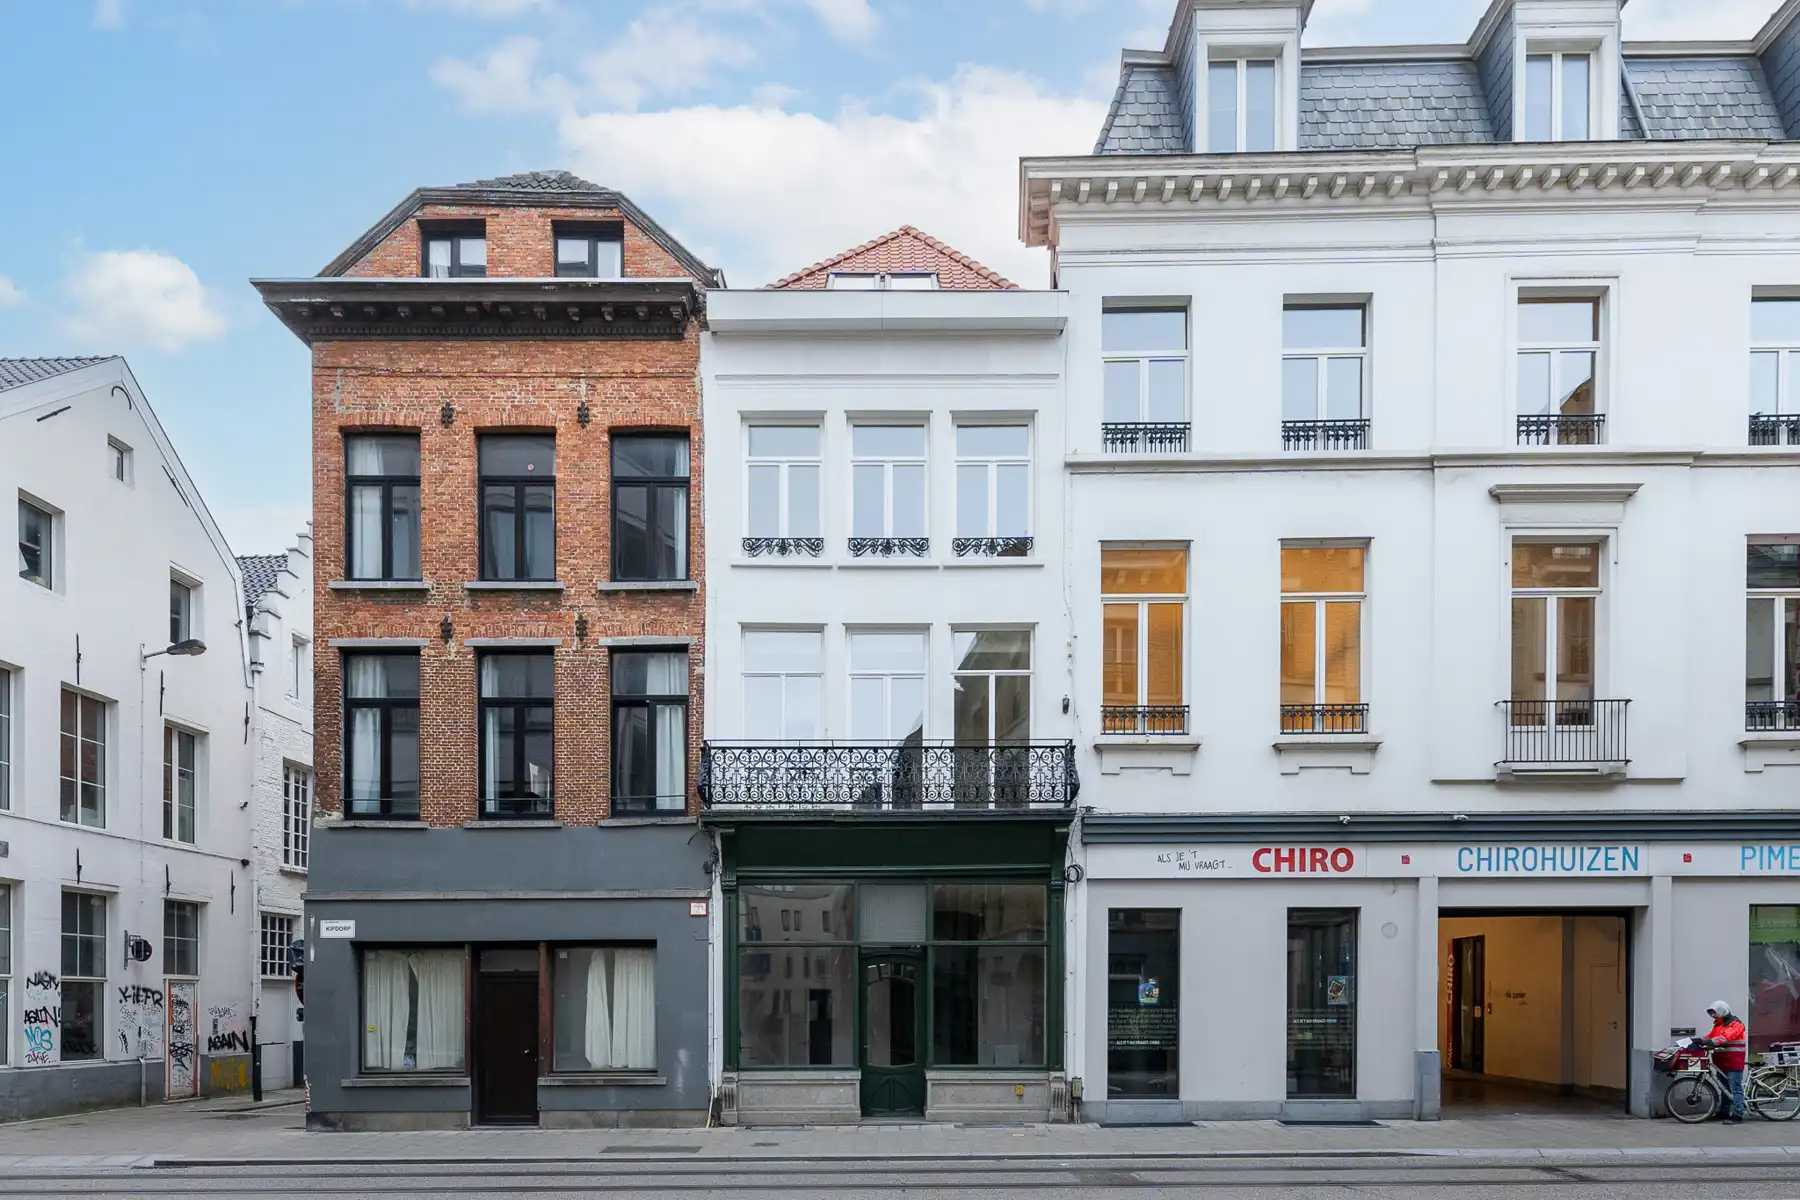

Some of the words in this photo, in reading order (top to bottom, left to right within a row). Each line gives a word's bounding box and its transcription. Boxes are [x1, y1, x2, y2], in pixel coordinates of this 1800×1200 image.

[1157, 853, 1172, 863] ALS
[1176, 851, 1185, 862] JE
[1178, 860, 1191, 871] MIJ
[1252, 847, 1354, 873] CHIRO
[1457, 846, 1639, 872] CHIROHUIZEN
[1741, 845, 1800, 870] PIME
[1446, 953, 1455, 1004] CHIRO
[207, 1030, 249, 1053] AGAIN
